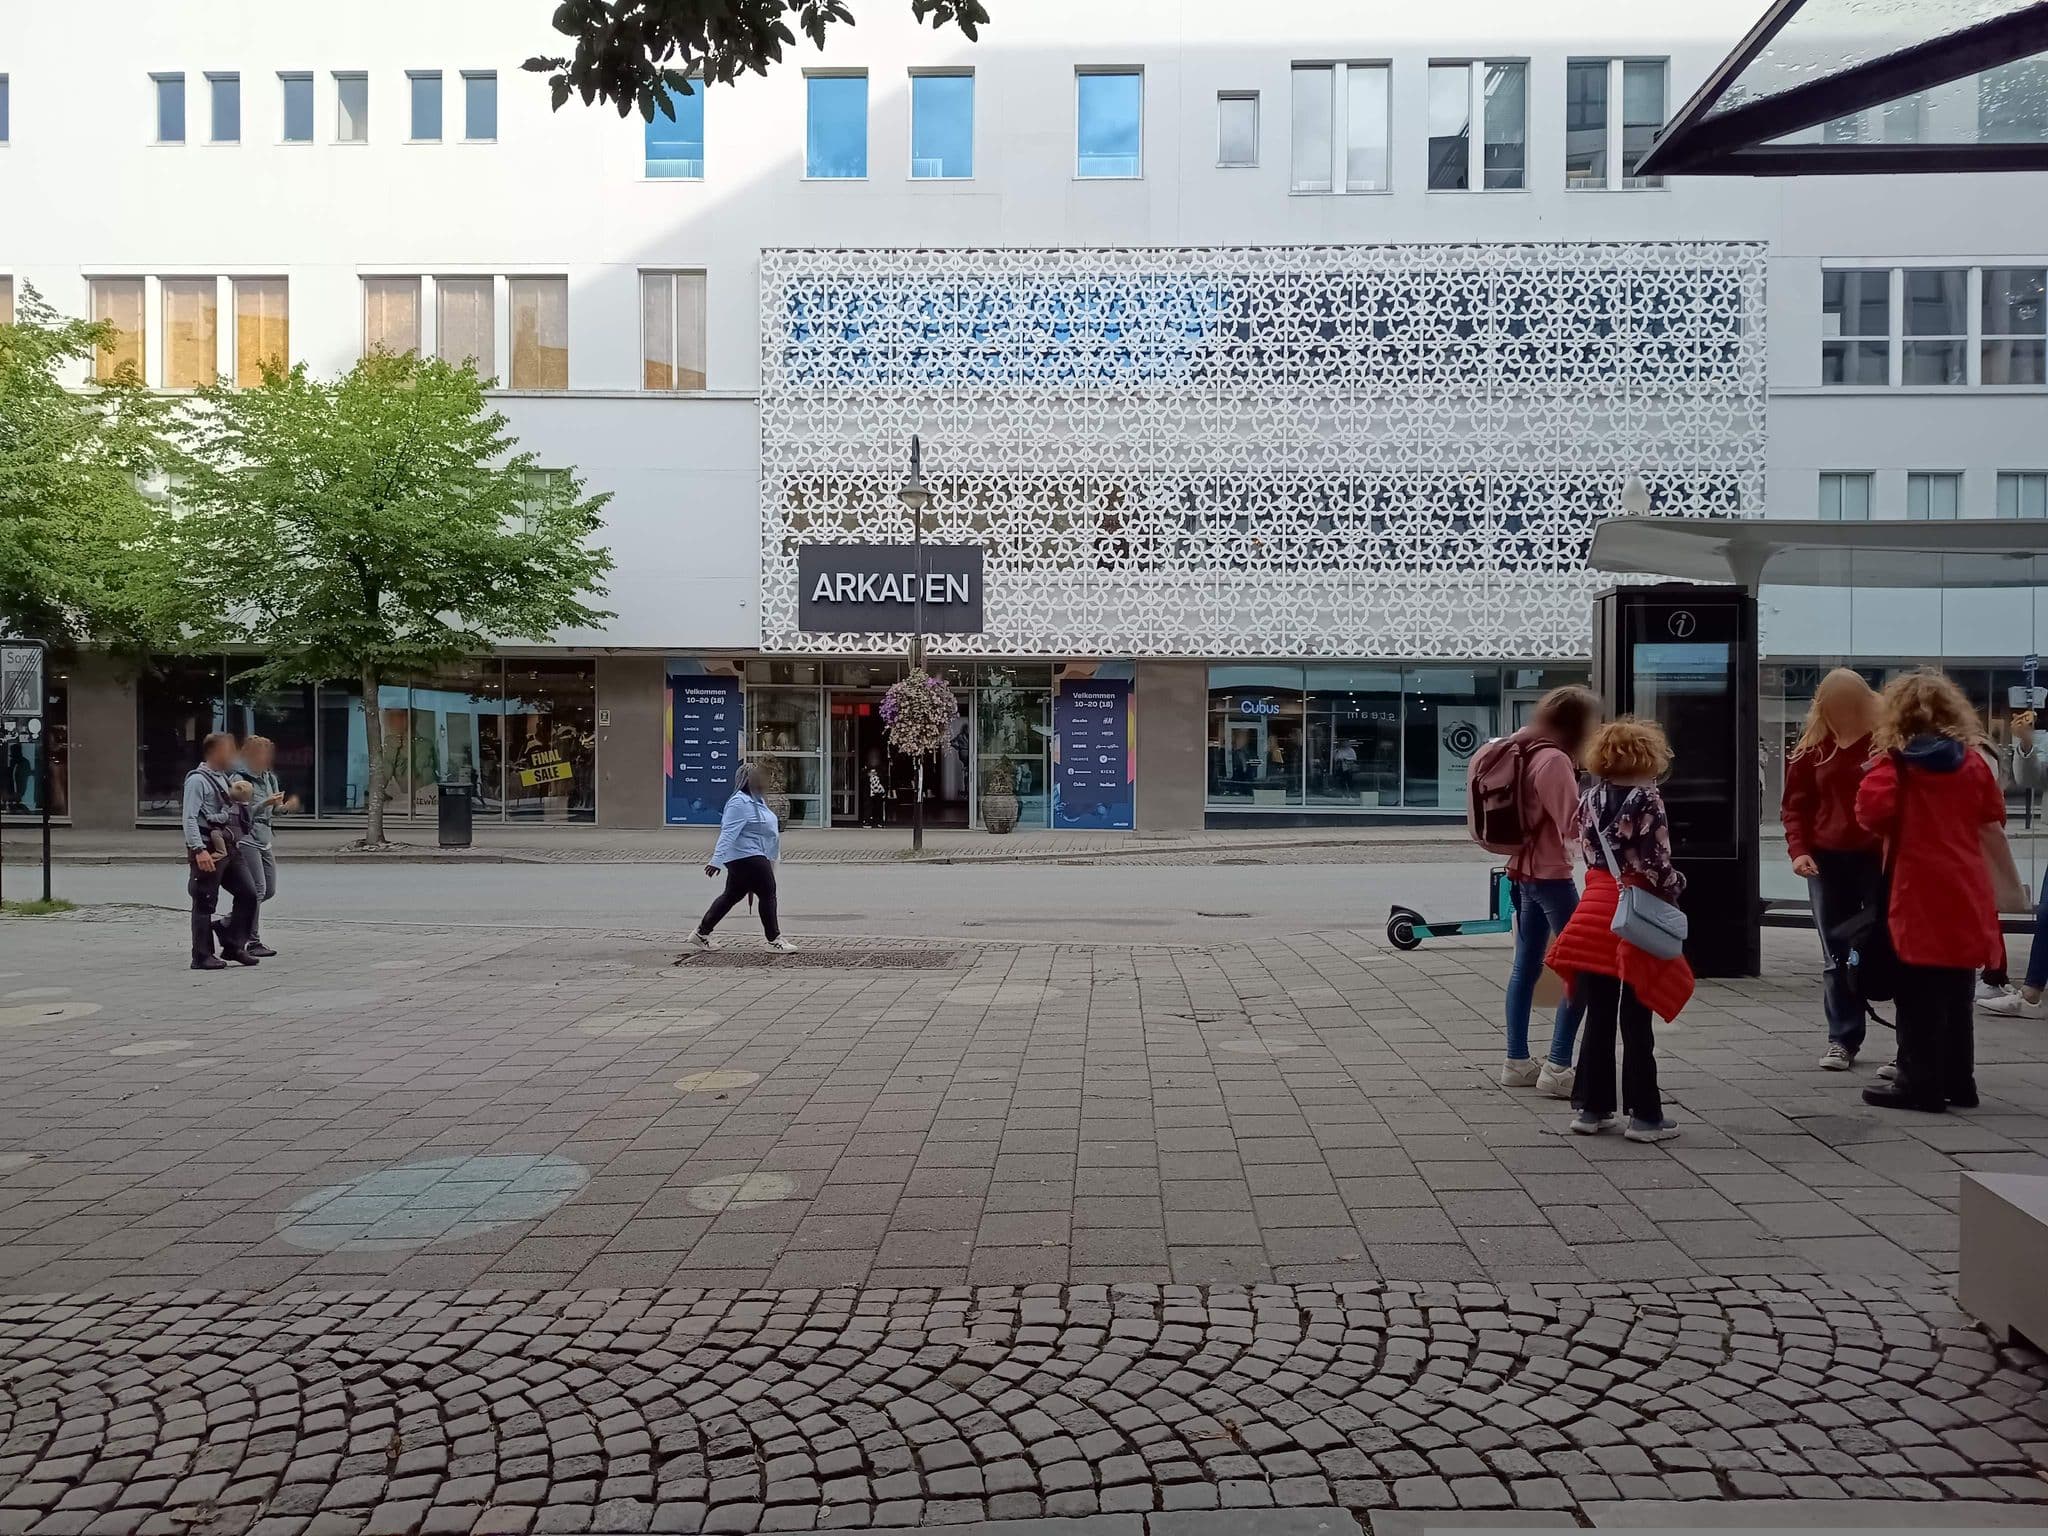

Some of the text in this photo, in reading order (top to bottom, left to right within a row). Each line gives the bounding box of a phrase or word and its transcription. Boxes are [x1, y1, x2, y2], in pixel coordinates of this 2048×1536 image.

[811, 572, 969, 603] ARKADEN
[1099, 700, 1114, 709] (18)
[1240, 700, 1280, 714] Cubus
[531, 749, 561, 766] FINAL
[533, 766, 560, 782] SALE
